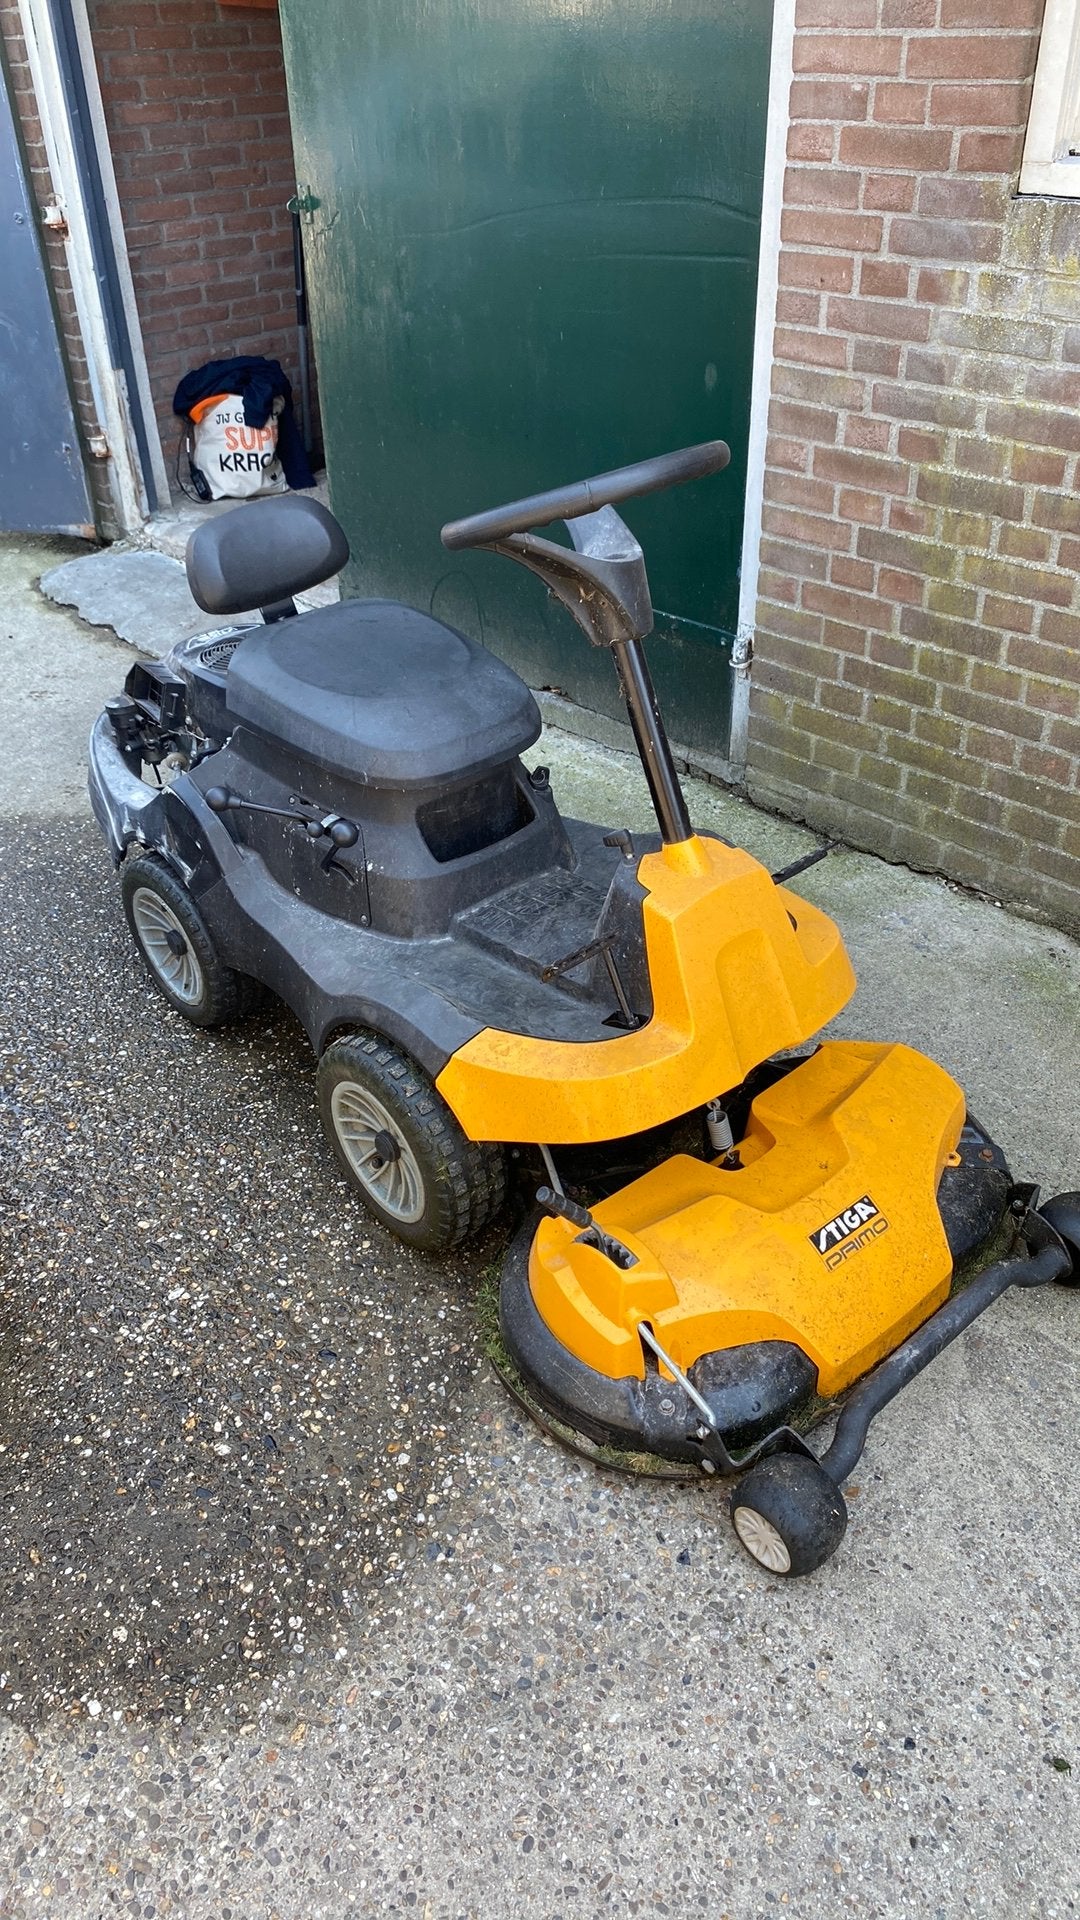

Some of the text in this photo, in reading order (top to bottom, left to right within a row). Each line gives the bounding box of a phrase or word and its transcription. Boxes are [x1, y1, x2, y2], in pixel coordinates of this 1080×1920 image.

[216, 413, 230, 424] JIJ
[219, 453, 275, 472] KRAC
[819, 1202, 878, 1253] STIGA
[825, 1217, 889, 1271] PRIMO
